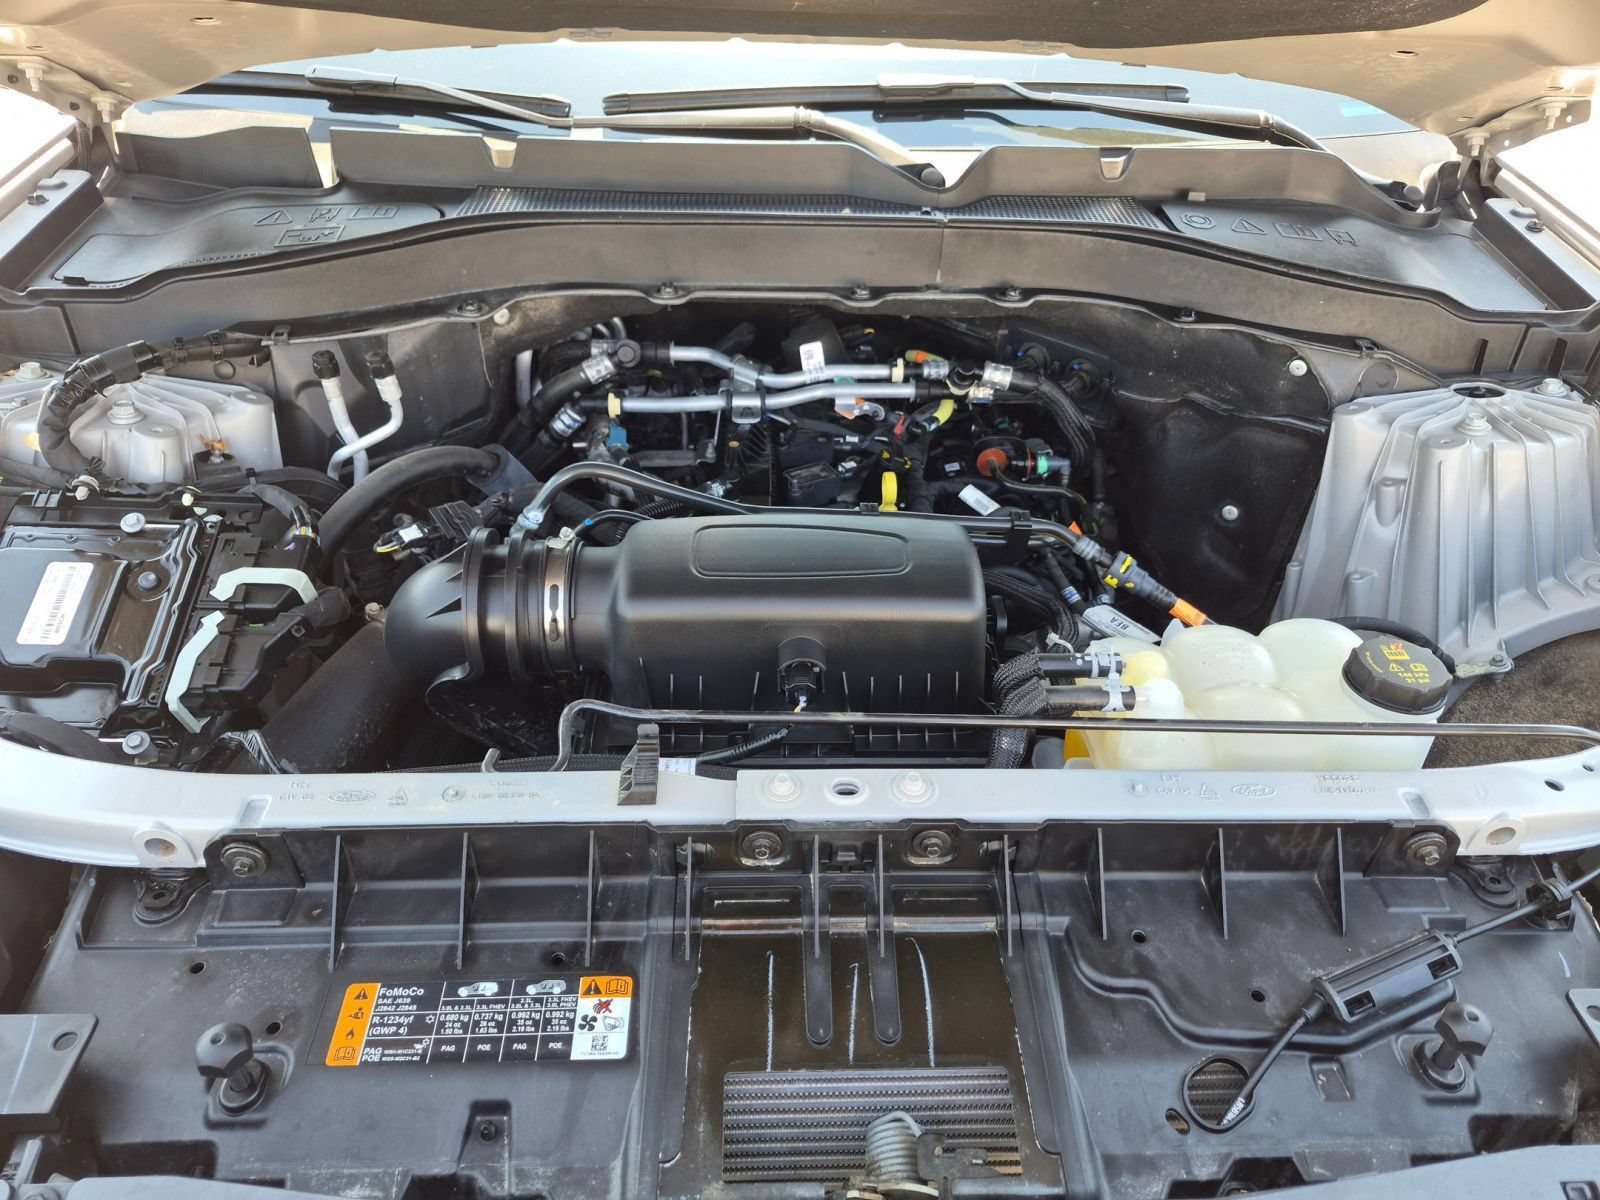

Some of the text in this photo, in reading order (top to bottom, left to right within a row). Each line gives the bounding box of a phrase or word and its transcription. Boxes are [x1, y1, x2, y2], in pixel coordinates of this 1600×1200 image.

[1110, 616, 1130, 631] BEA
[378, 987, 424, 996] FoMoCo
[460, 1014, 469, 1022] kg
[494, 1013, 504, 1021] kg
[531, 1011, 541, 1020] kg
[565, 1010, 575, 1019] kg
[372, 1016, 414, 1024] R-1234yf
[369, 1026, 408, 1036] (GWP 4)
